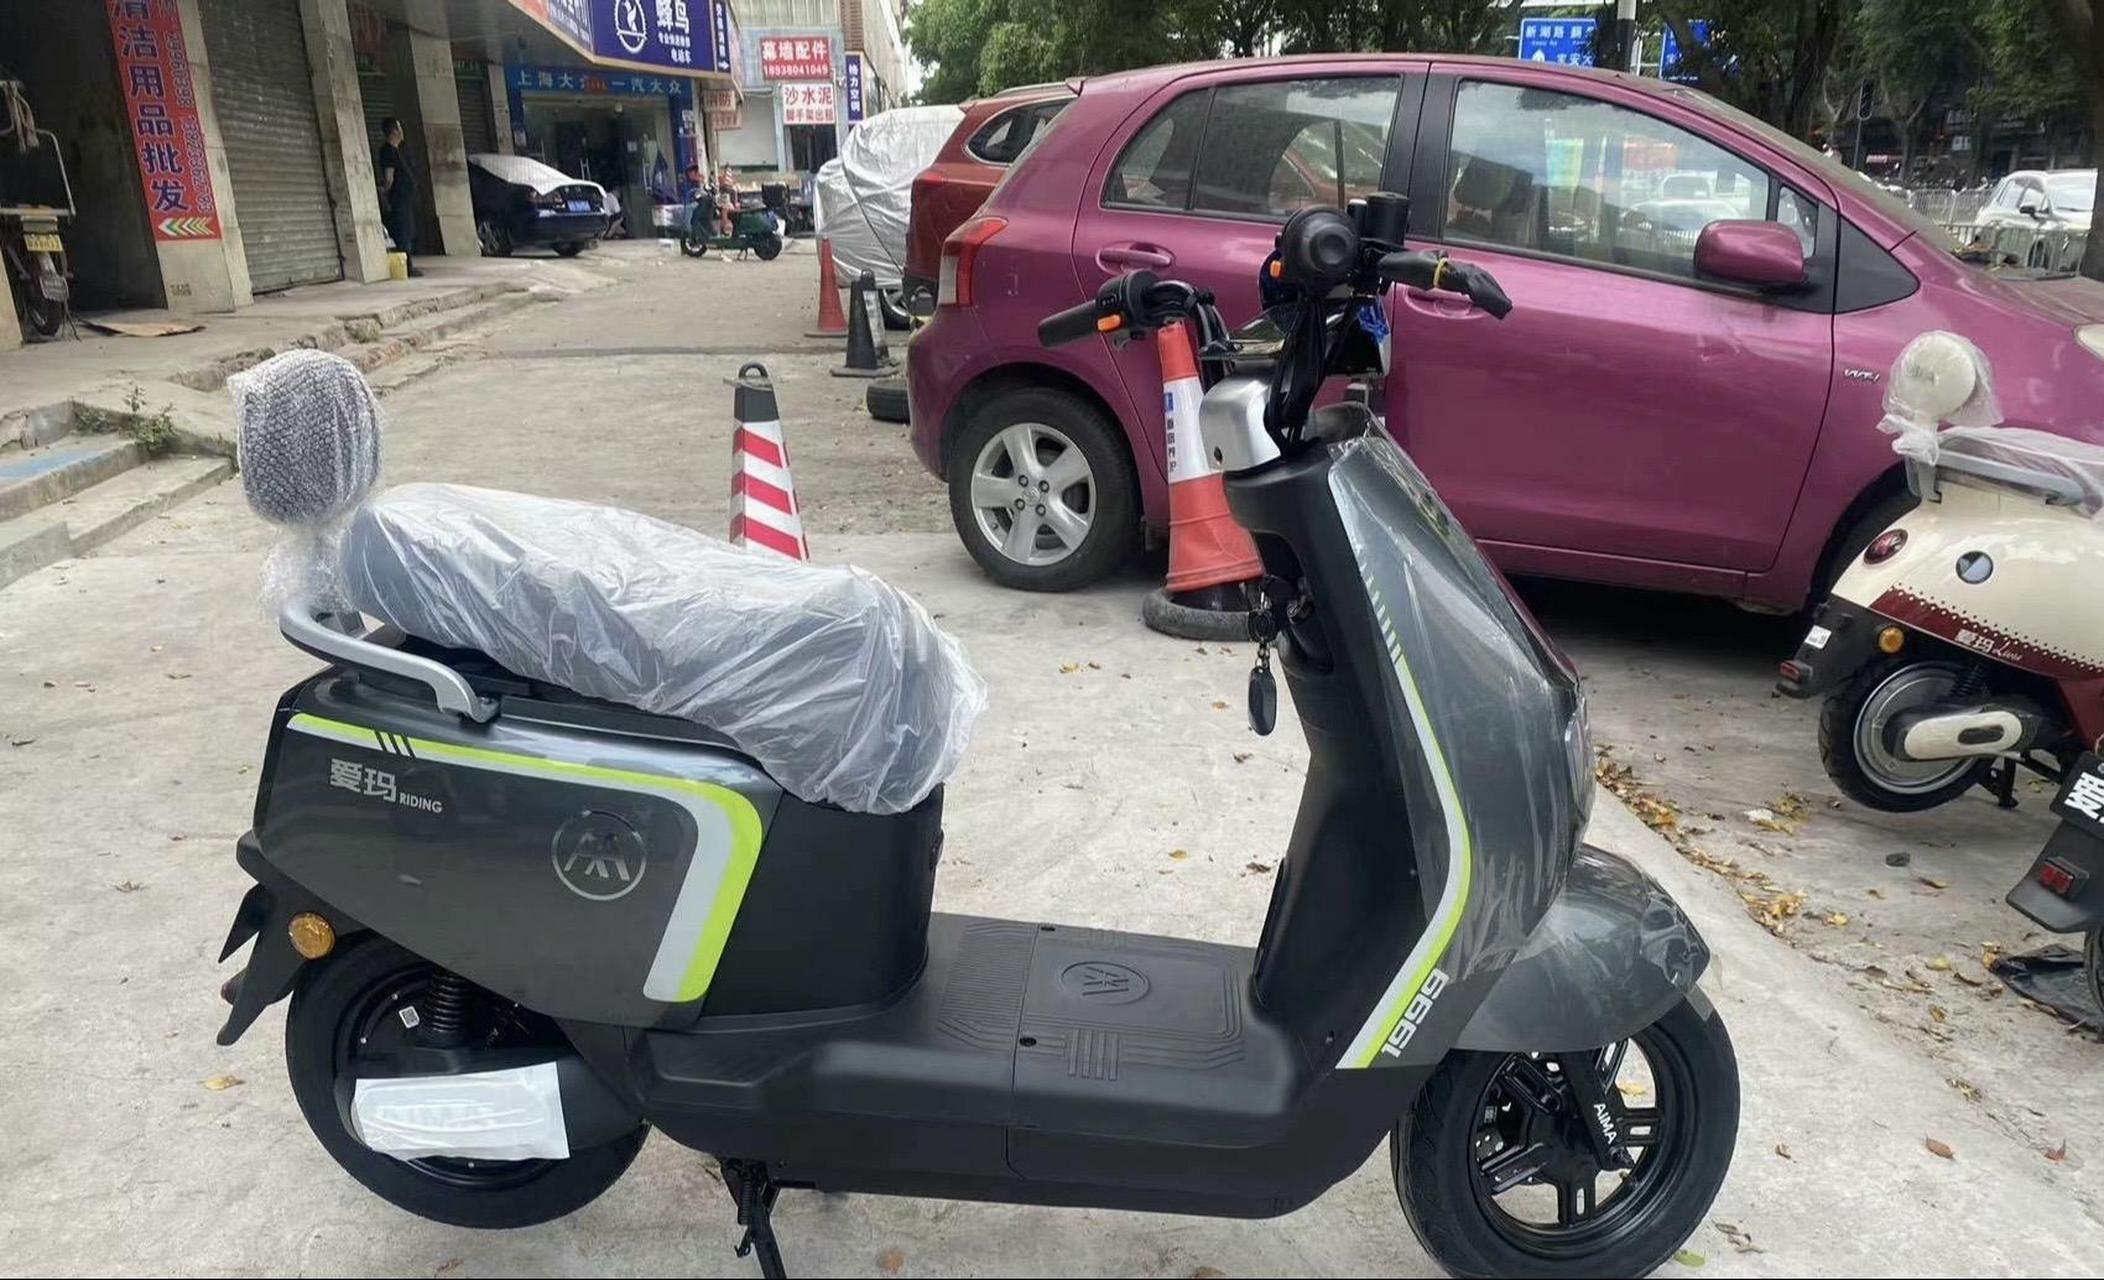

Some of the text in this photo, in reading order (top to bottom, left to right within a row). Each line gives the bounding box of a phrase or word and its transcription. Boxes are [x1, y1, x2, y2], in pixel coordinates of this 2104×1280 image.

[762, 40, 828, 60] 幕墙配件
[611, 77, 682, 95] 一汽大众
[763, 64, 829, 77] 18938041049
[785, 86, 833, 105] 沙水泥
[329, 757, 443, 814] 爱玛 RIDING
[2063, 770, 2104, 824] 爱
[1381, 967, 1450, 1059] 1999
[1593, 1101, 1618, 1145] AIMA
